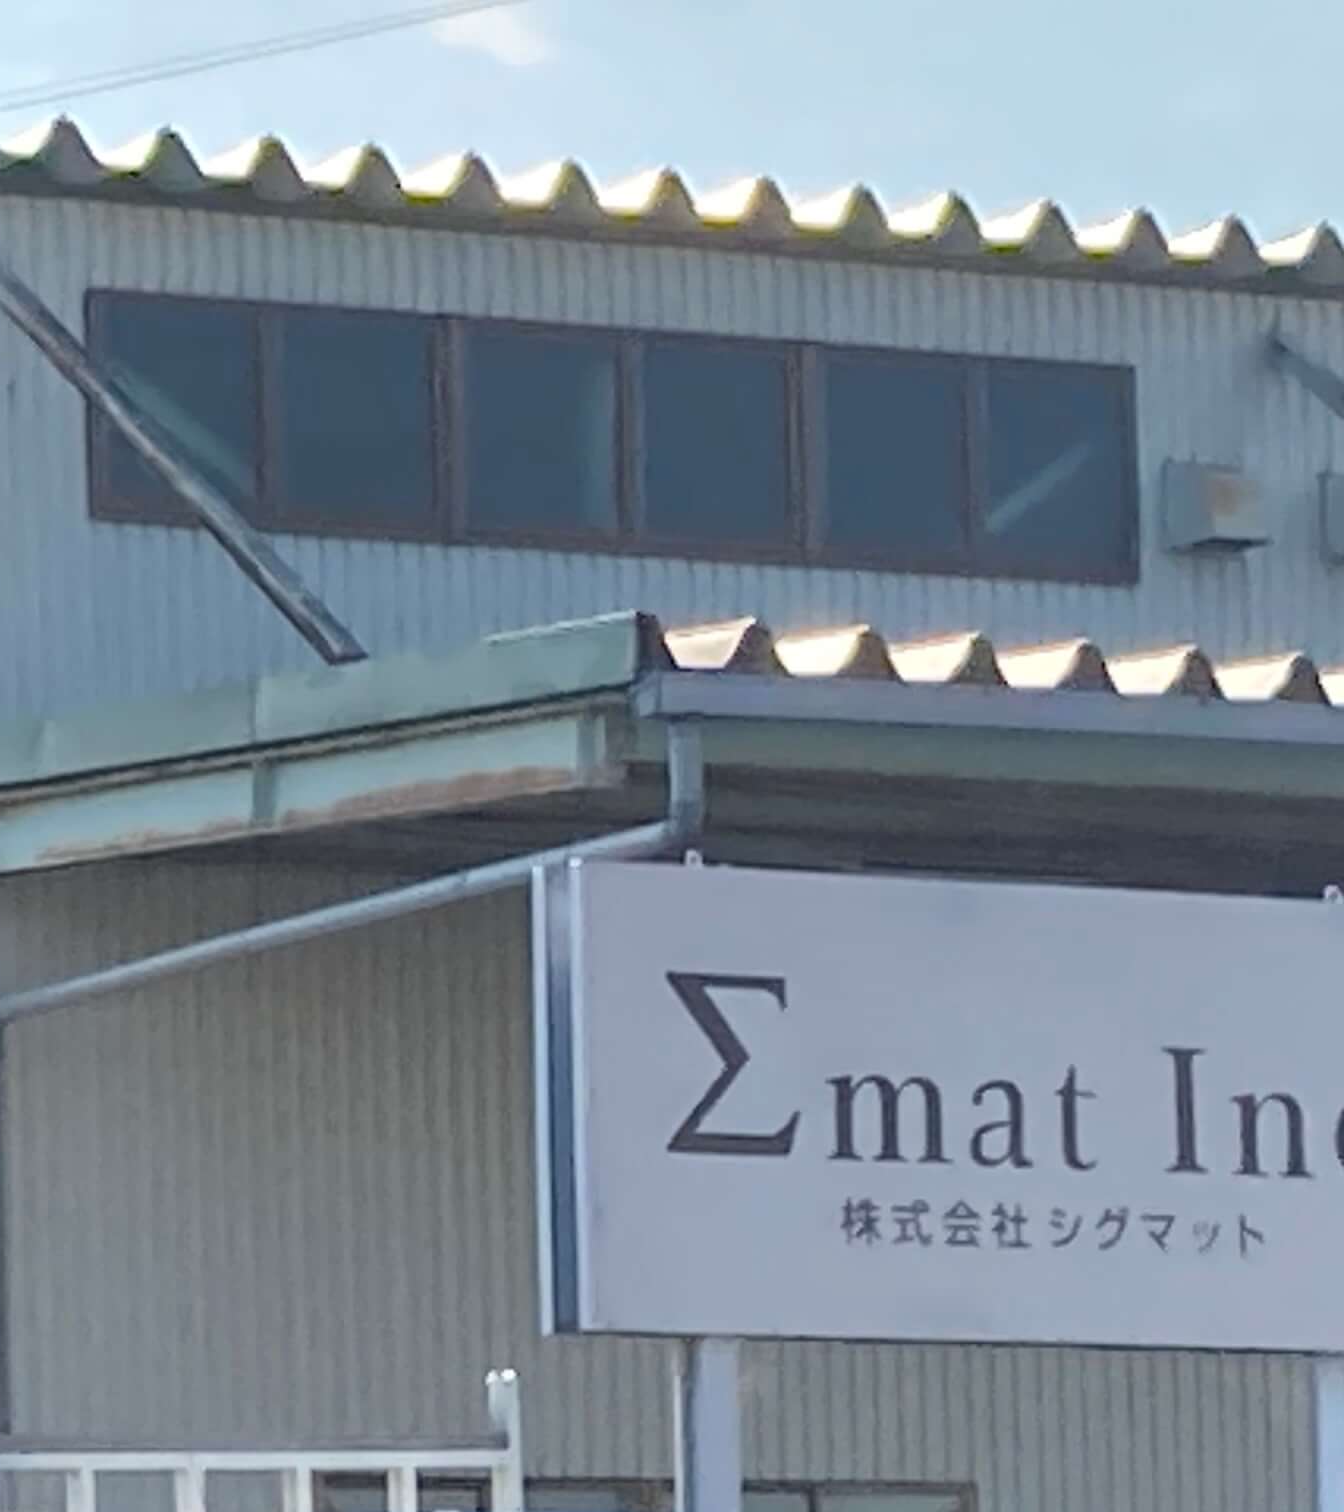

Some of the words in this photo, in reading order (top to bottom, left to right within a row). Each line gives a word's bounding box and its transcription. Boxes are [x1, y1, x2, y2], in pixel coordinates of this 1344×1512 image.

[839, 1196, 1265, 1258] 株式会社シグマット
